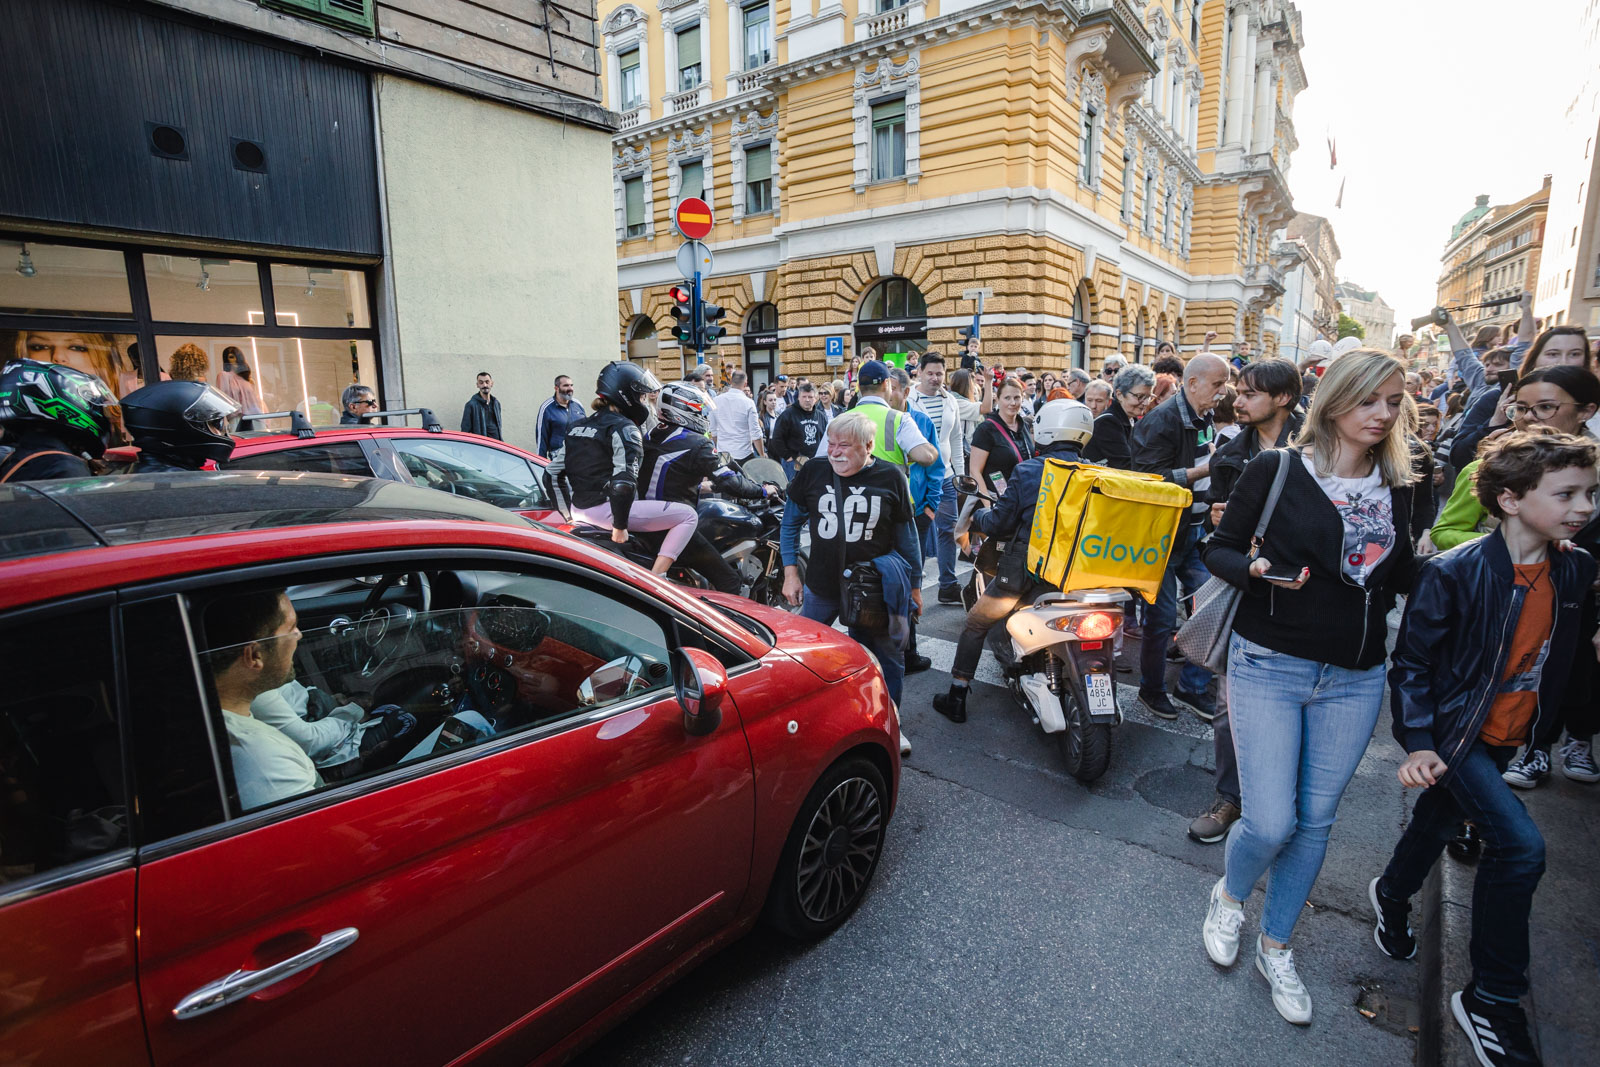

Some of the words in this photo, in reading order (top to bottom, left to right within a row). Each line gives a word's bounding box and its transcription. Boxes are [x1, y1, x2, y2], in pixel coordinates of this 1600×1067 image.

[1034, 473, 1055, 528] Glovo
[1080, 534, 1159, 565] Glovo
[1094, 679, 1105, 688] ZG
[1090, 688, 1111, 698] 4854
[1097, 698, 1107, 707] JC
